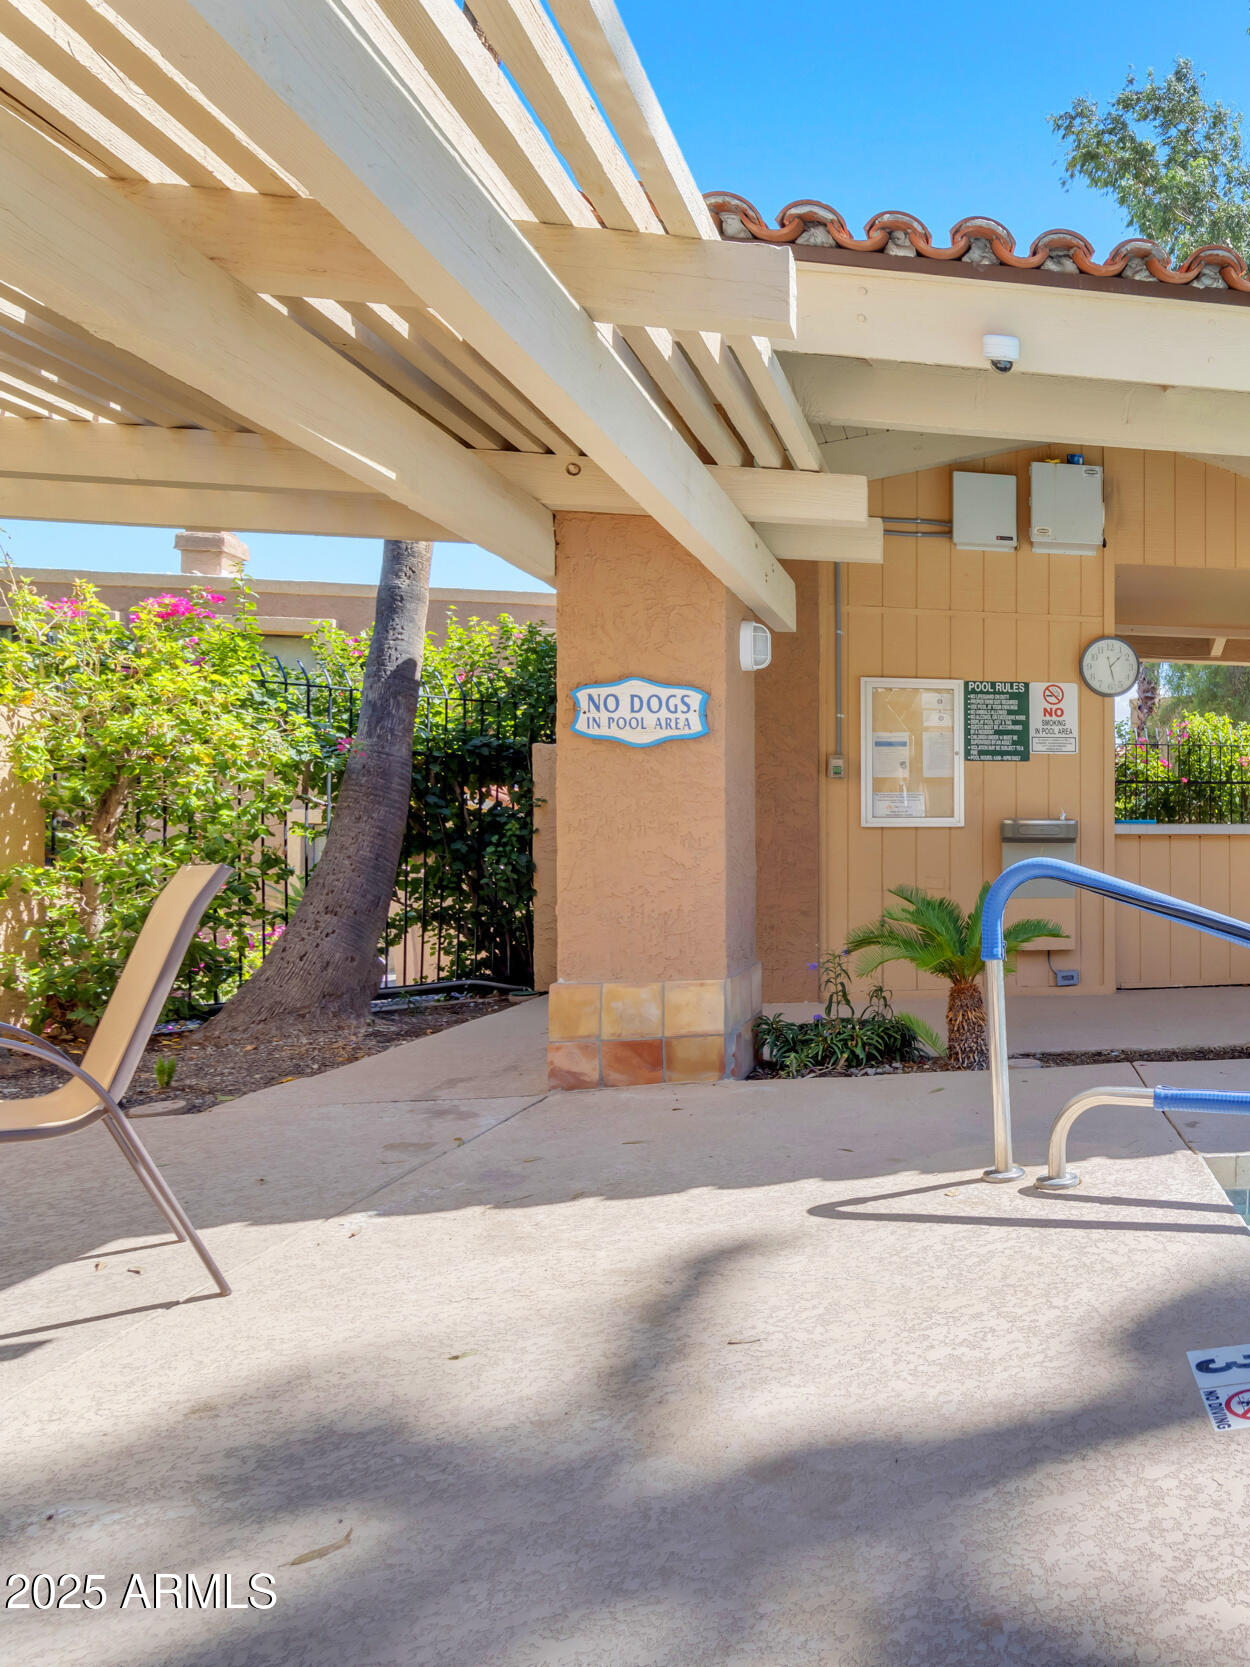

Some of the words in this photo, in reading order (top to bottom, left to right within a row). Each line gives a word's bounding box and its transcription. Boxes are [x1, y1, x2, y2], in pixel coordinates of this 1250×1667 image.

[969, 682, 993, 691] POOL
[996, 683, 1025, 692] RULES
[587, 693, 620, 713] NO
[630, 694, 691, 714] DOGS
[1043, 707, 1064, 718] NO
[587, 717, 600, 729] IN
[608, 717, 647, 729] POOL
[654, 717, 691, 730] AREA
[1203, 1390, 1220, 1401] NO
[1208, 1402, 1232, 1430] DIVING
